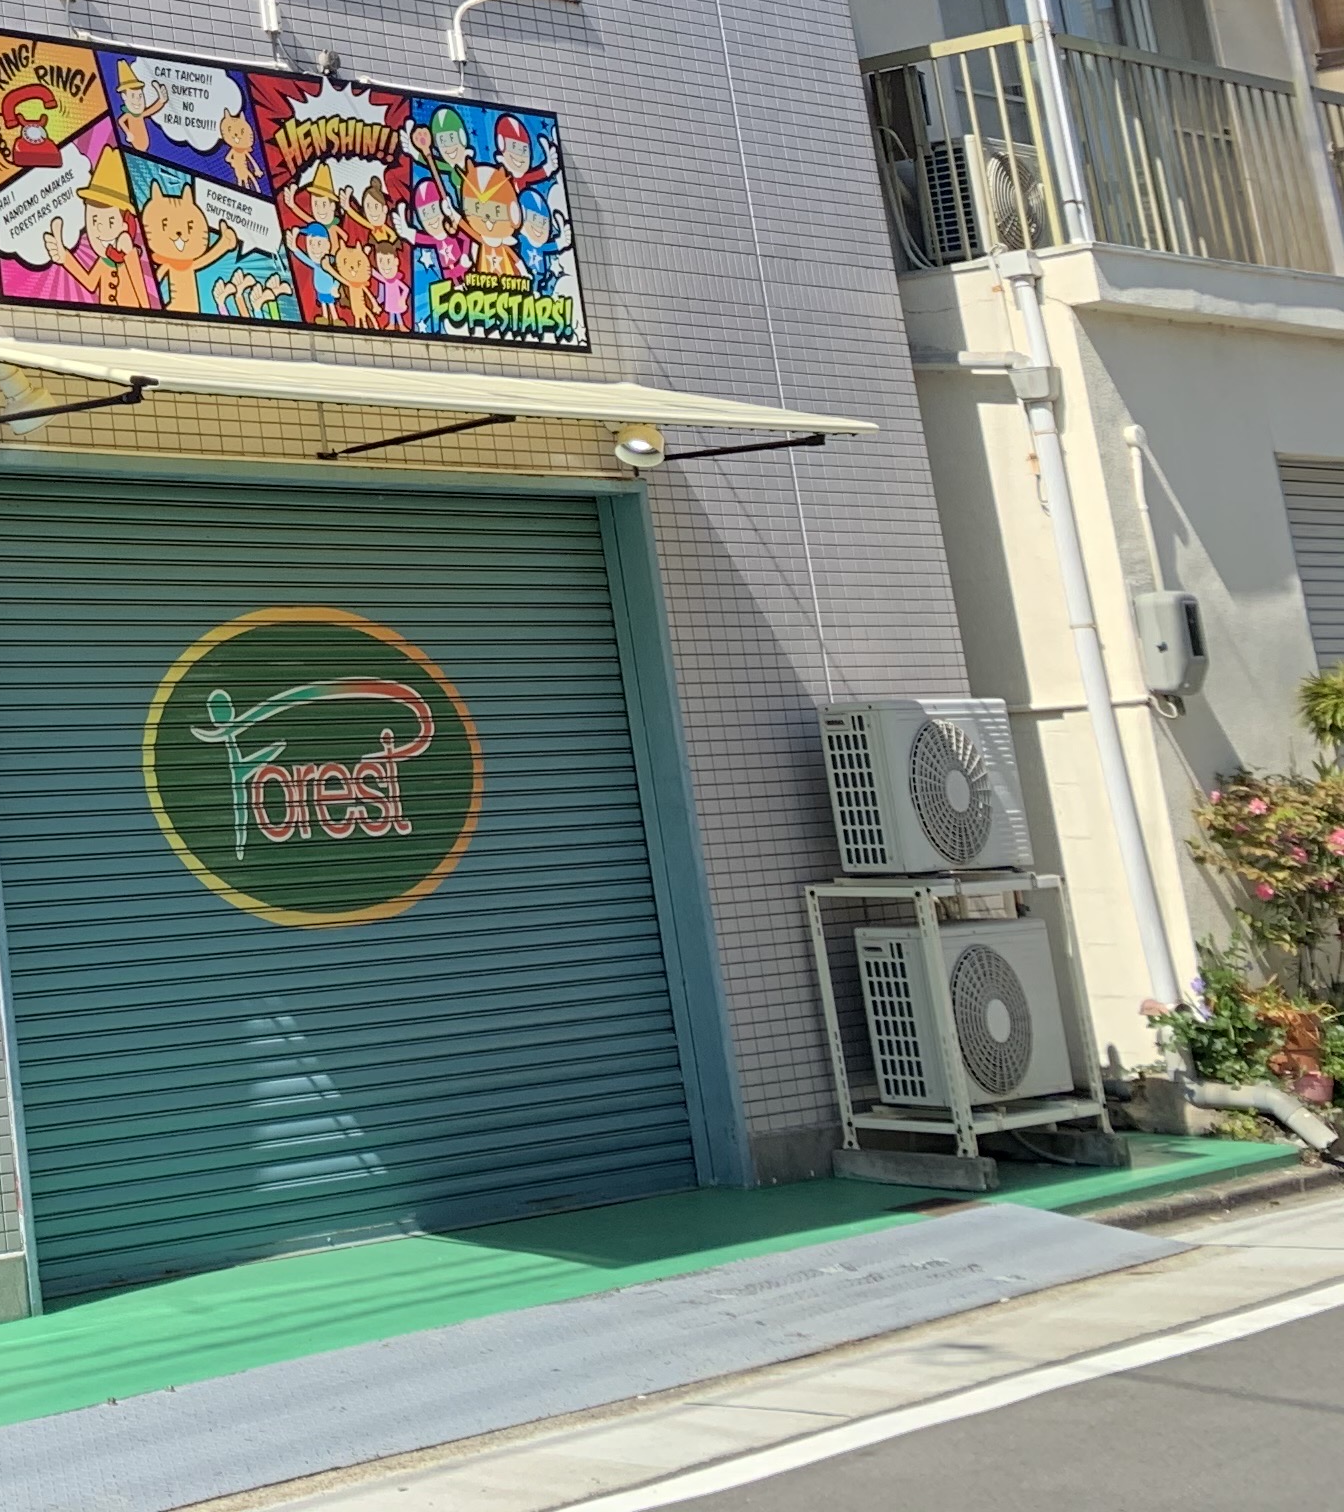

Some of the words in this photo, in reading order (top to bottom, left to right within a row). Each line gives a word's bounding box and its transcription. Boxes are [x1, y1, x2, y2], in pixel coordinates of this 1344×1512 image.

[34, 65, 97, 103] RING!
[155, 66, 172, 78] CAT
[175, 70, 212, 85] TAICHO!!
[172, 84, 209, 99] SUKETTO
[183, 101, 194, 112] NO
[164, 114, 181, 125] IRAI
[275, 116, 399, 173] HENSHIN!!
[3, 194, 40, 225] NANDEMO
[40, 169, 75, 199] OMAKASE
[206, 189, 253, 216] FORESTARS
[9, 203, 52, 239] FORESTARS
[465, 273, 498, 289] HELPER
[501, 275, 530, 291] SENTAI
[429, 280, 573, 336] FORESTARS!
[189, 676, 435, 862] Forest
